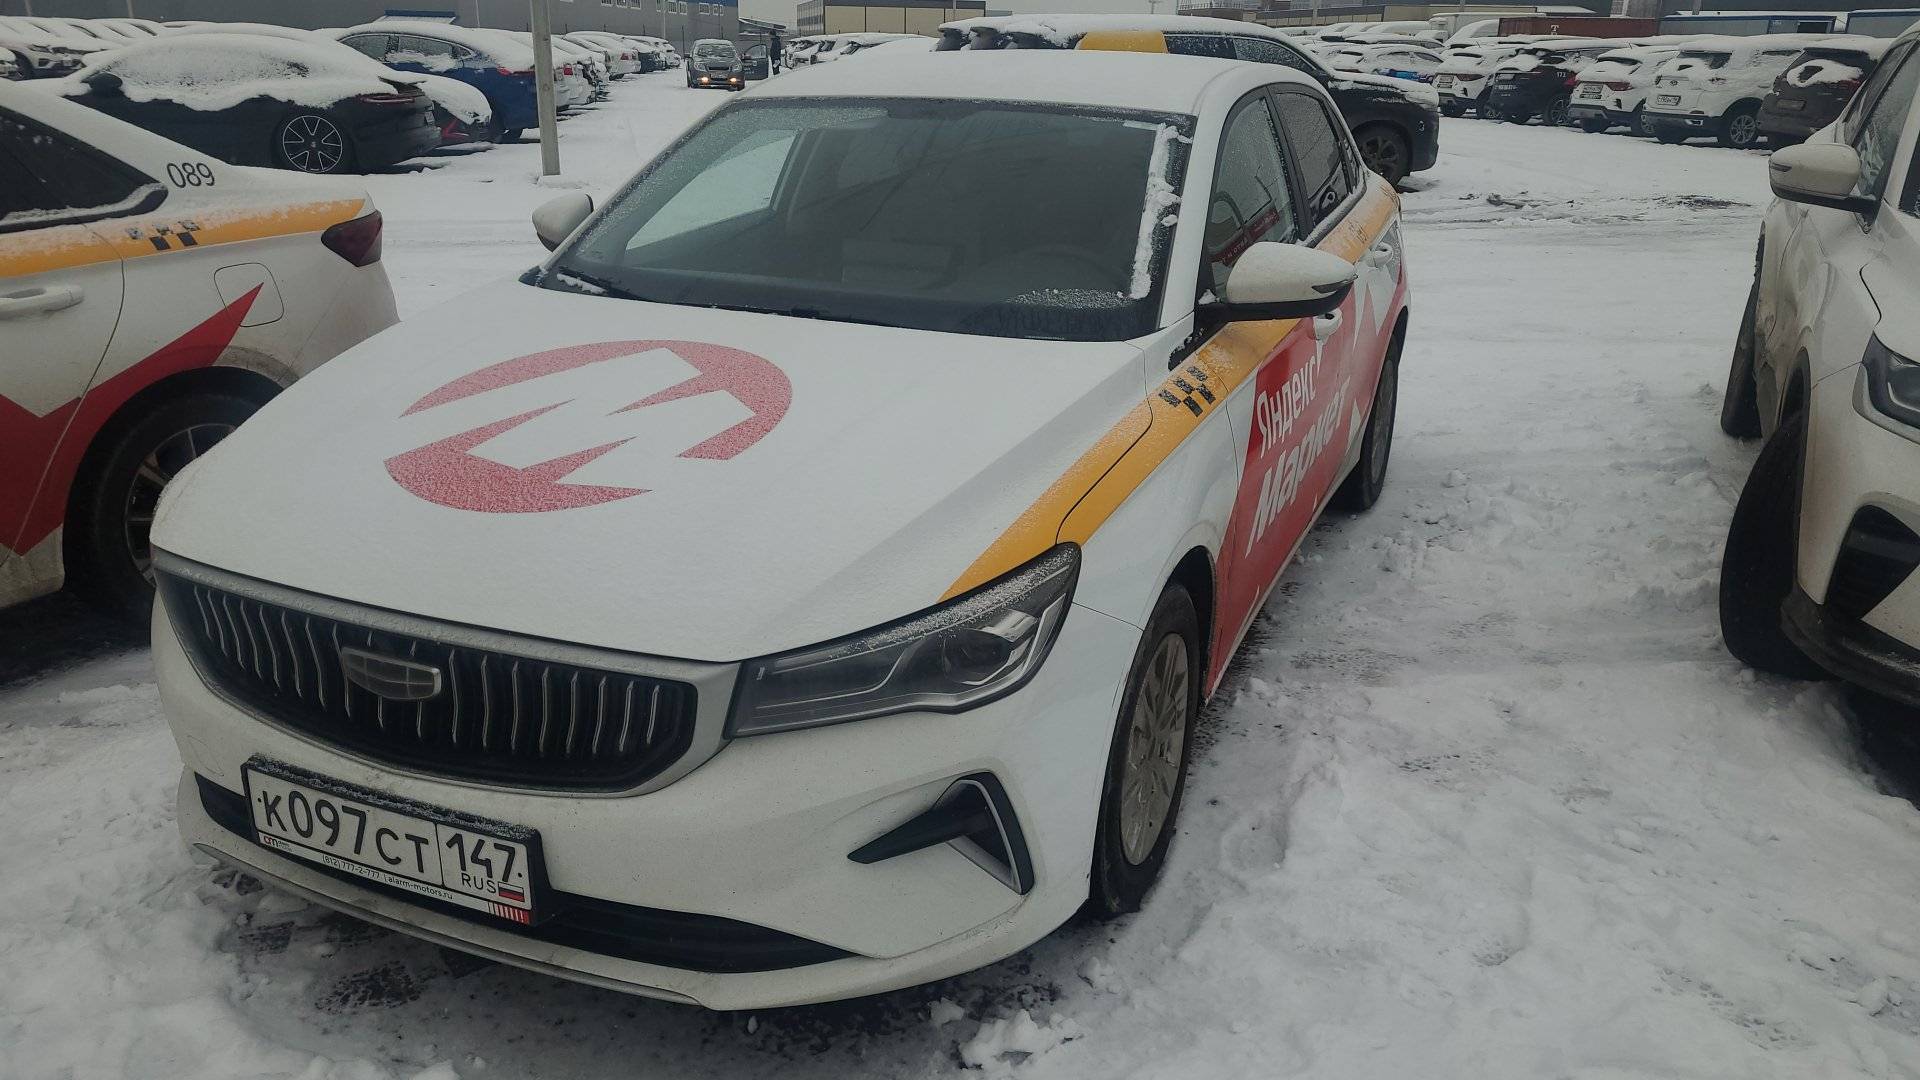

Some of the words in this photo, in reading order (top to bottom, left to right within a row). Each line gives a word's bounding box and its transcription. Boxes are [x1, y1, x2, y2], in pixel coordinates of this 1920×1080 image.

[167, 163, 215, 188] 089
[1257, 355, 1316, 459] Яндекс
[1245, 376, 1350, 559] Маркет
[446, 832, 517, 882] 147
[388, 875, 454, 900] alarm-motors.ru
[462, 873, 497, 894] RUS
